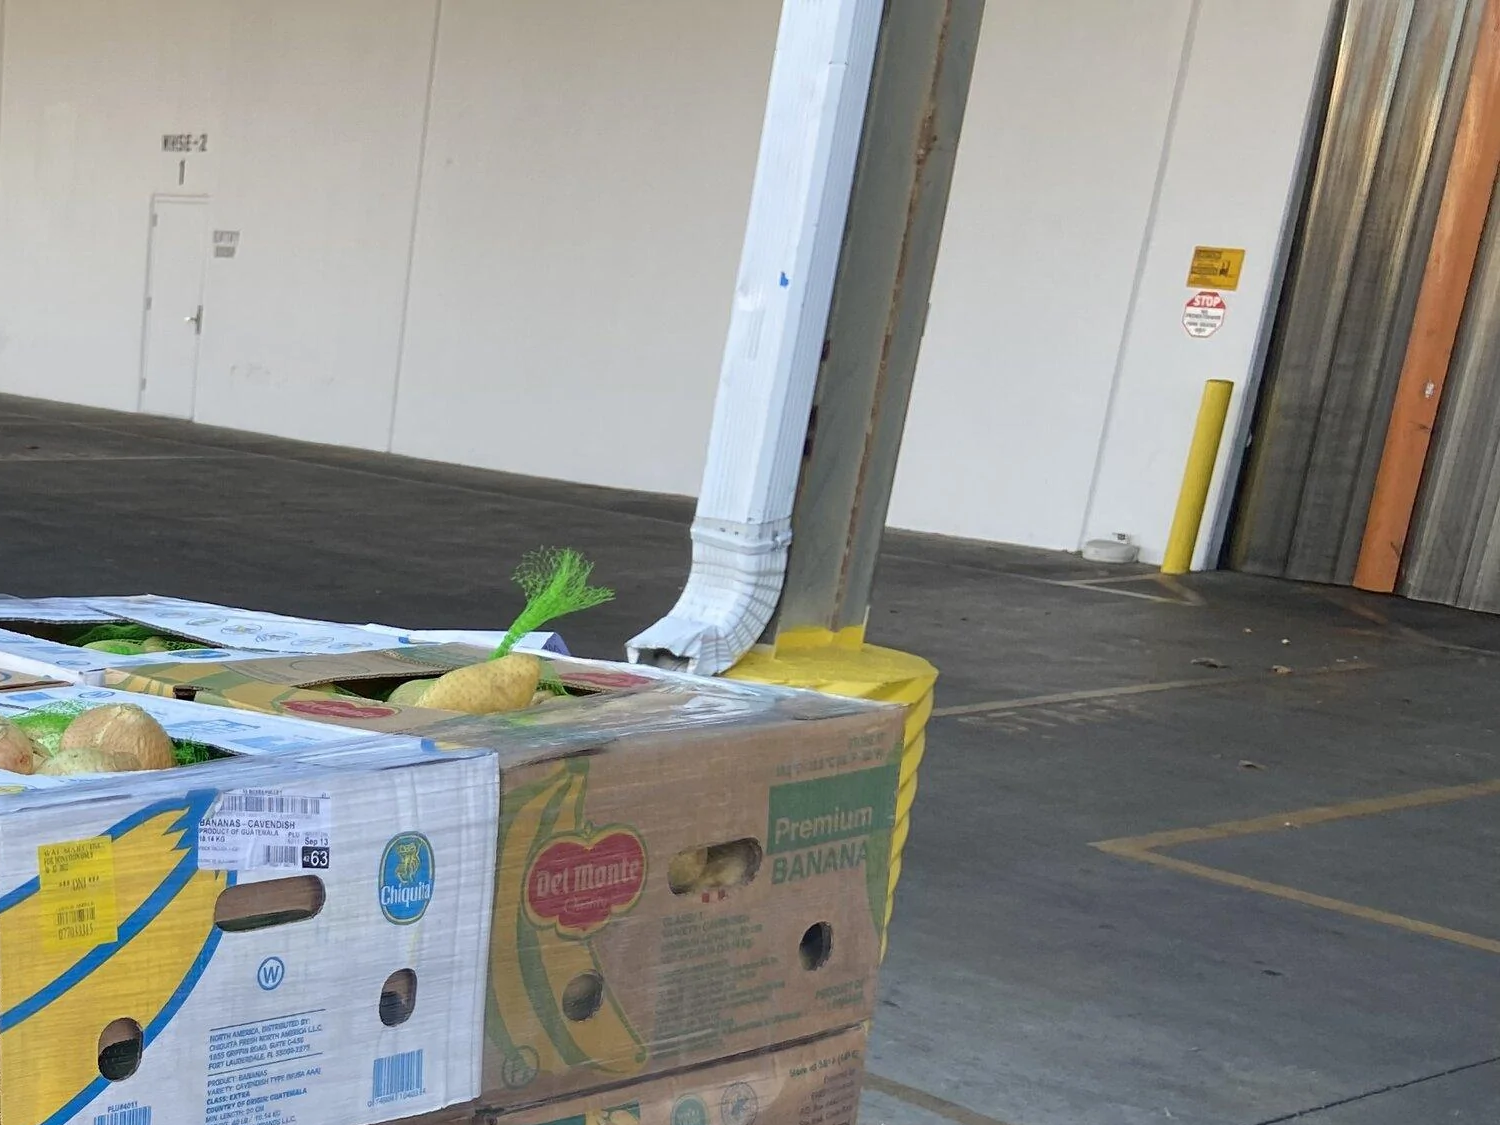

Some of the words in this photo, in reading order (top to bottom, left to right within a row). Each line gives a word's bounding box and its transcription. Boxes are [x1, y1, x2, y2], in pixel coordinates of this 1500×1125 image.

[1194, 295, 1221, 307] STOP
[200, 819, 241, 828] BANANAS
[247, 820, 295, 829] CAVENDISH
[775, 805, 873, 844] Premium
[241, 828, 279, 836] GUATEMALA
[304, 837, 318, 846] Sep
[310, 850, 328, 867] 63
[536, 867, 568, 897] Del
[574, 857, 640, 892] Monte
[381, 881, 431, 907] Chiquita
[263, 965, 280, 983] W
[261, 1020, 299, 1034] DISTRIBUTED
[239, 1037, 258, 1047] FRESH
[259, 1033, 280, 1042] NORTH
[280, 1028, 307, 1039] AMERICA
[208, 1061, 225, 1070] FORT
[270, 1075, 285, 1084] TYPE
[206, 1103, 236, 1114] COUNTRY
[269, 1087, 307, 1101] GUATEMALA
[229, 1090, 251, 1101] EXTRA
